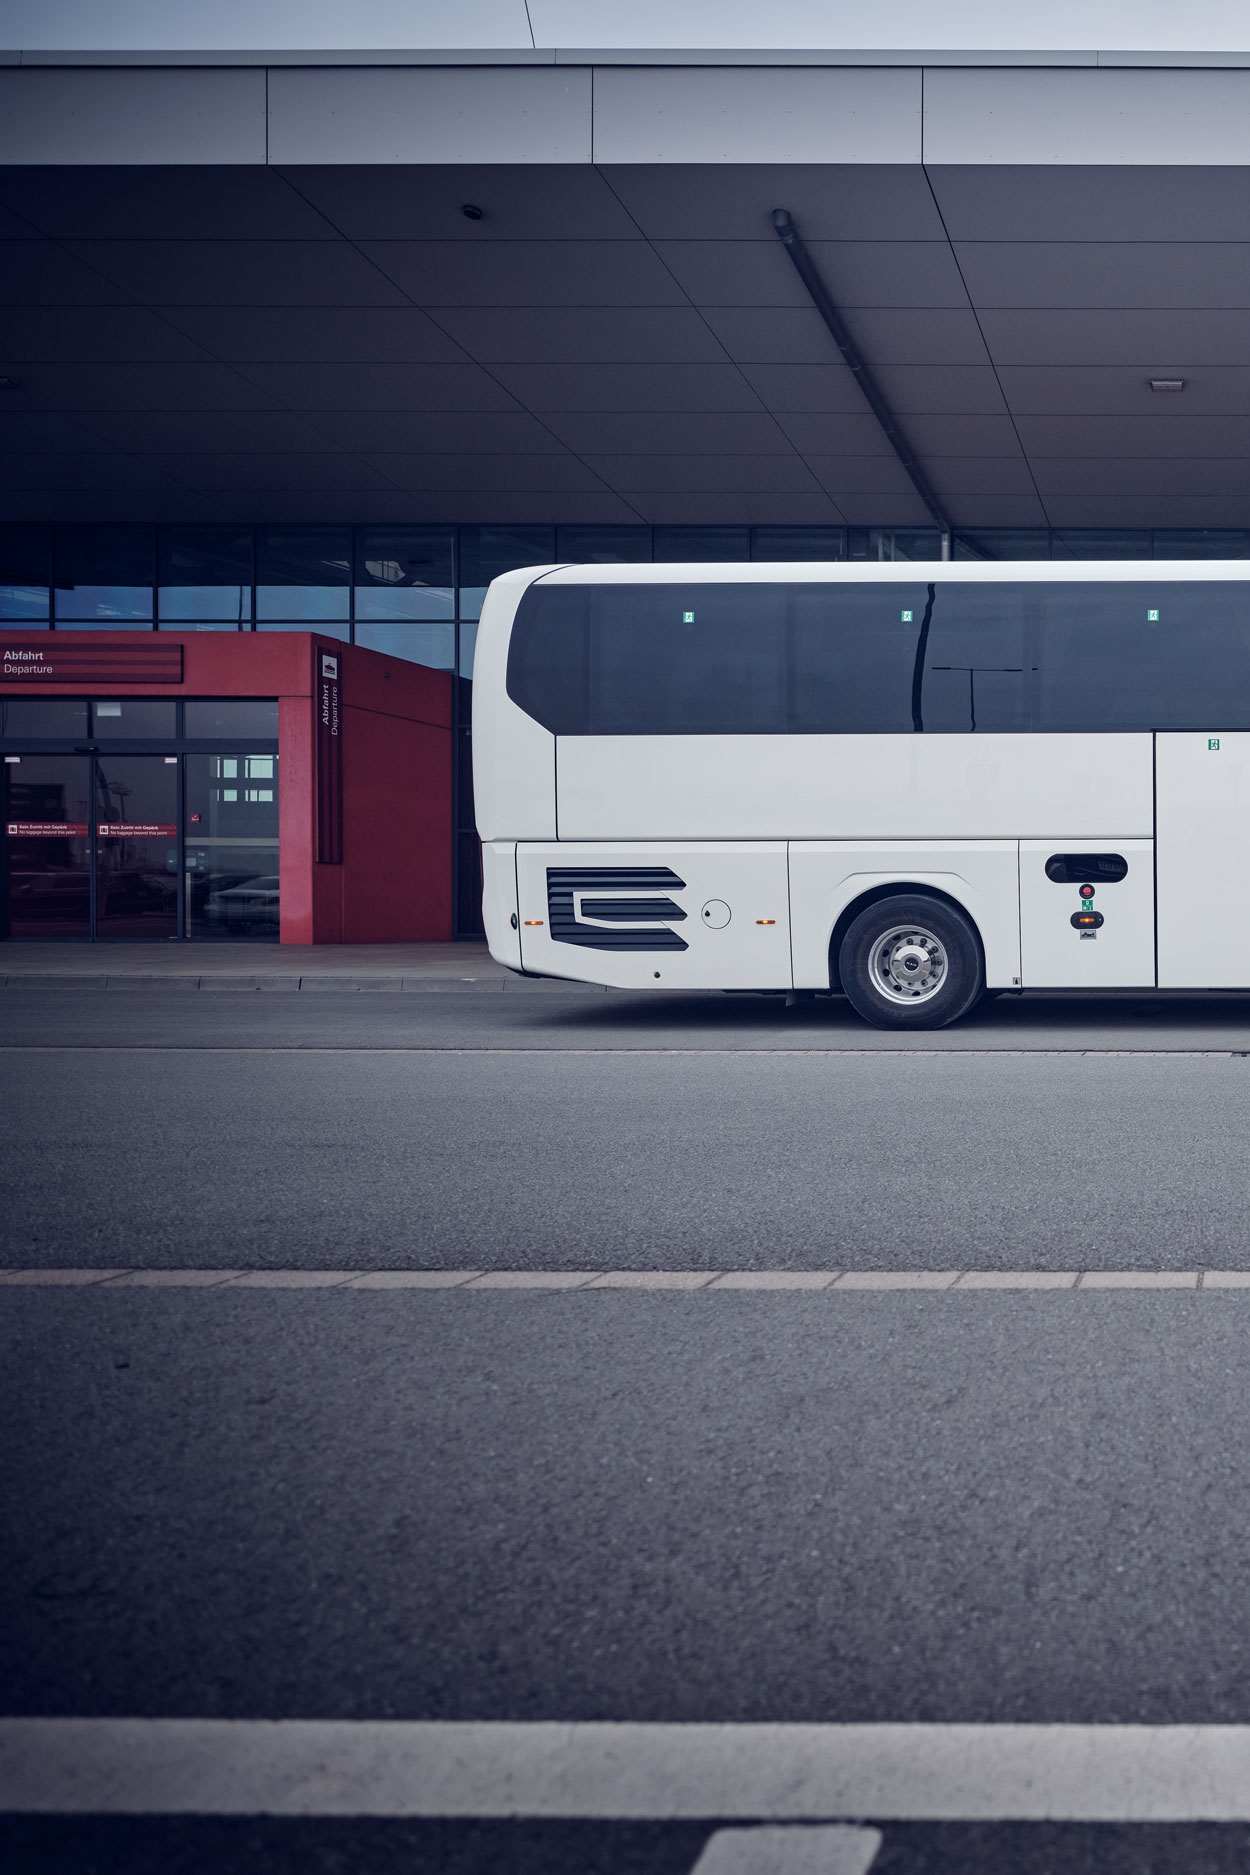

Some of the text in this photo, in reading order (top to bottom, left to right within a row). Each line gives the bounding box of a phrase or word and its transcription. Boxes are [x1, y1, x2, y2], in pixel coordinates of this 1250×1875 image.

[3, 651, 44, 660] Abfahrt
[4, 664, 53, 675] Departure
[331, 686, 339, 735] Departure
